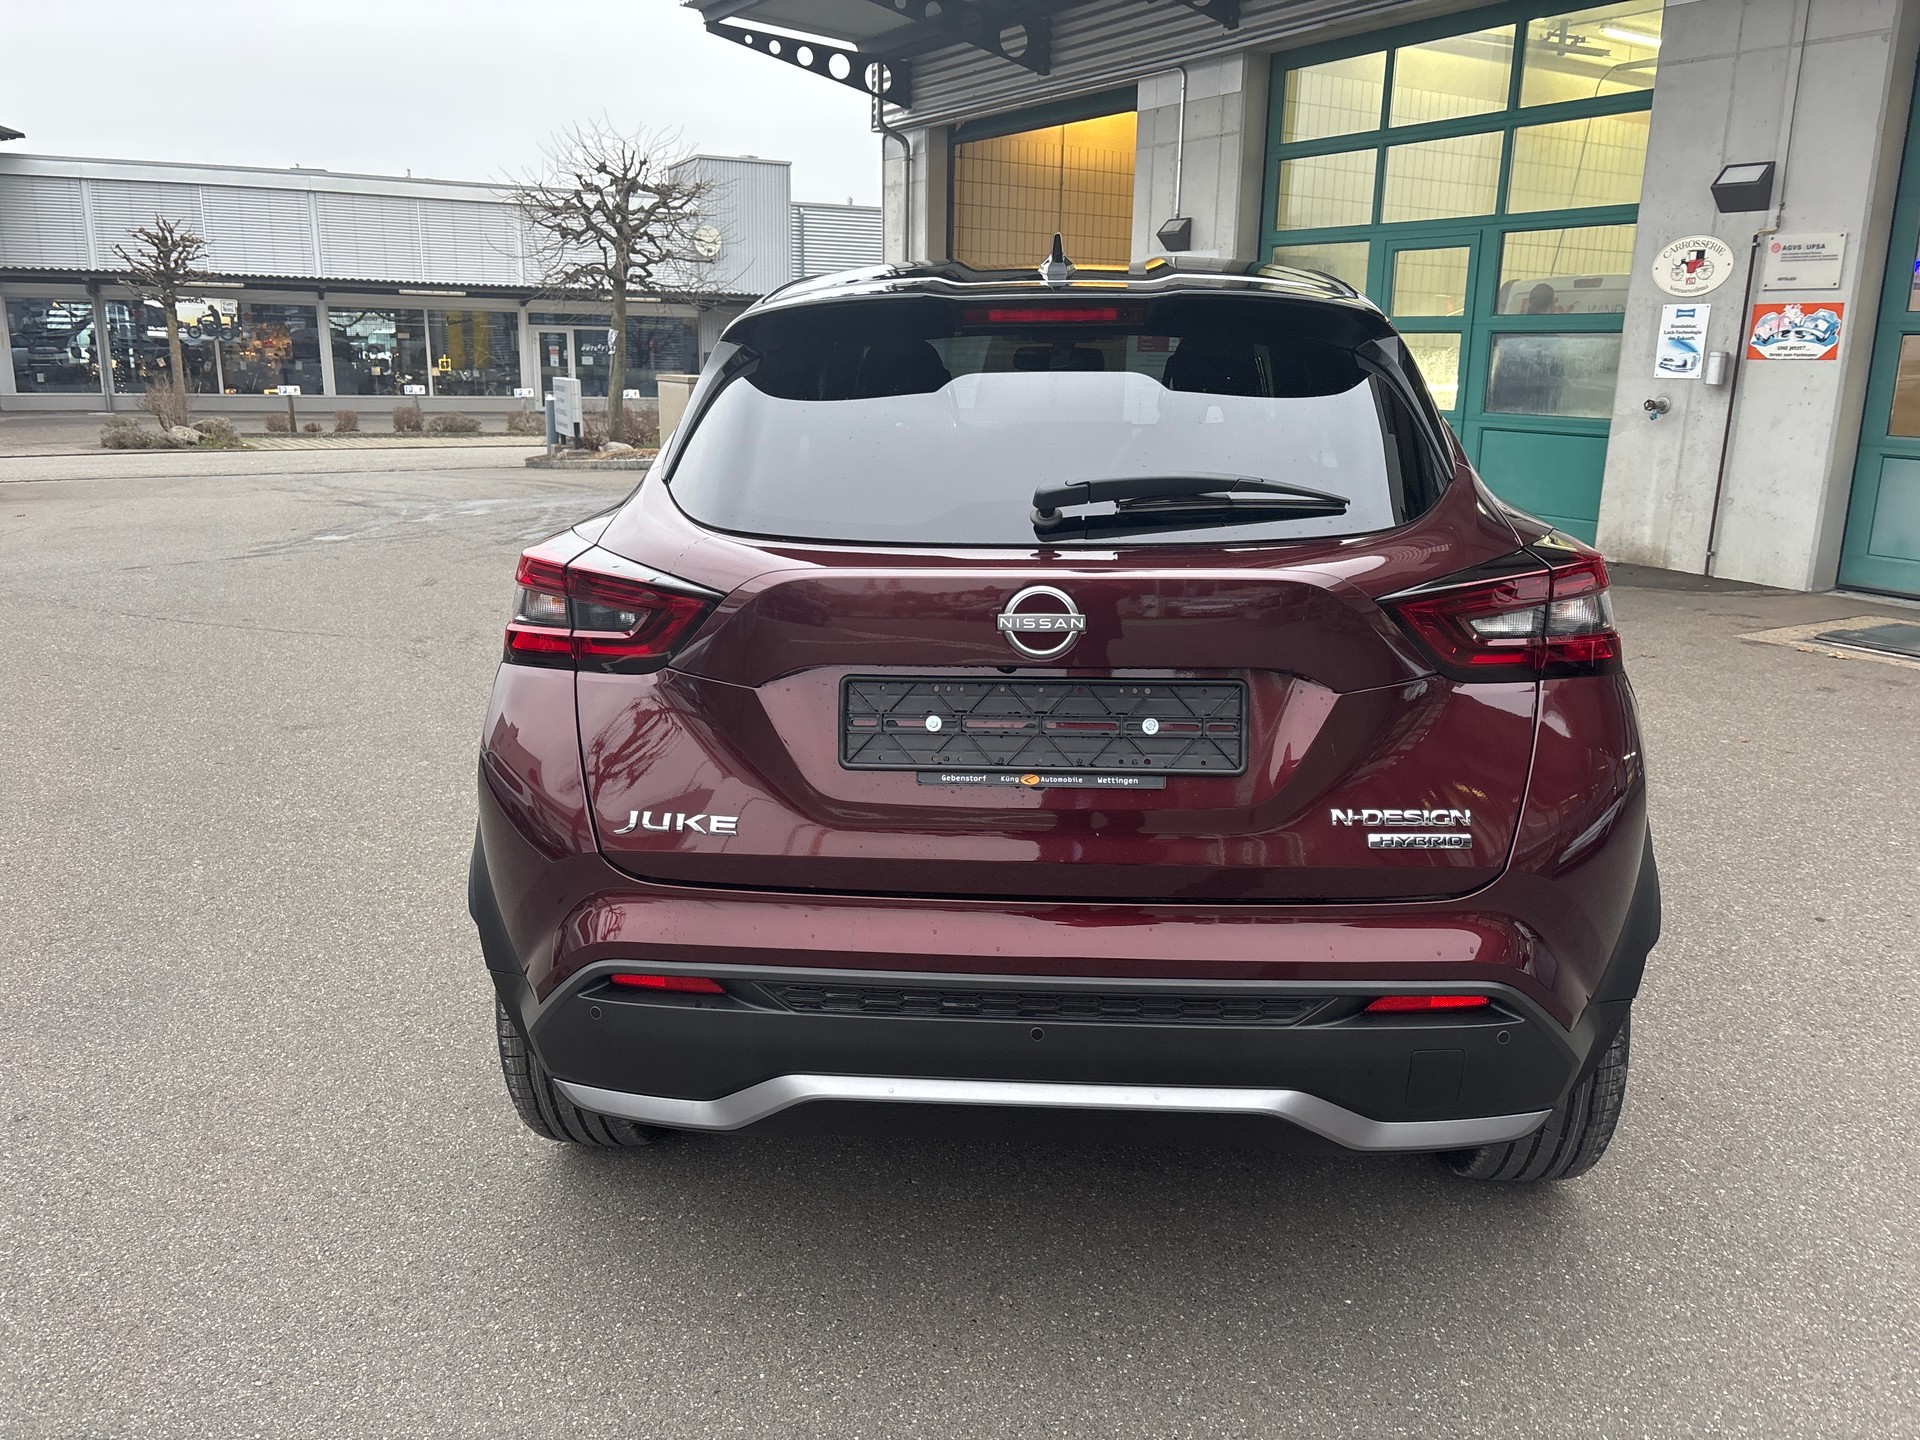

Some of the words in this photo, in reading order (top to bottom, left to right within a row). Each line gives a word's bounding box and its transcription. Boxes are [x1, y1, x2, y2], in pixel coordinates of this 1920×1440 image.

[1663, 240, 1727, 258] CARROSSERIE
[1000, 617, 1084, 629] NISSAN
[941, 774, 987, 783] Gebenstorf
[1000, 774, 1020, 784] Küng
[1040, 776, 1083, 784] Automobile
[1097, 777, 1139, 786] Wettingen
[613, 810, 739, 836] JUKE
[1330, 808, 1471, 827] N-DESIGN
[1379, 835, 1464, 847] HYBRID
